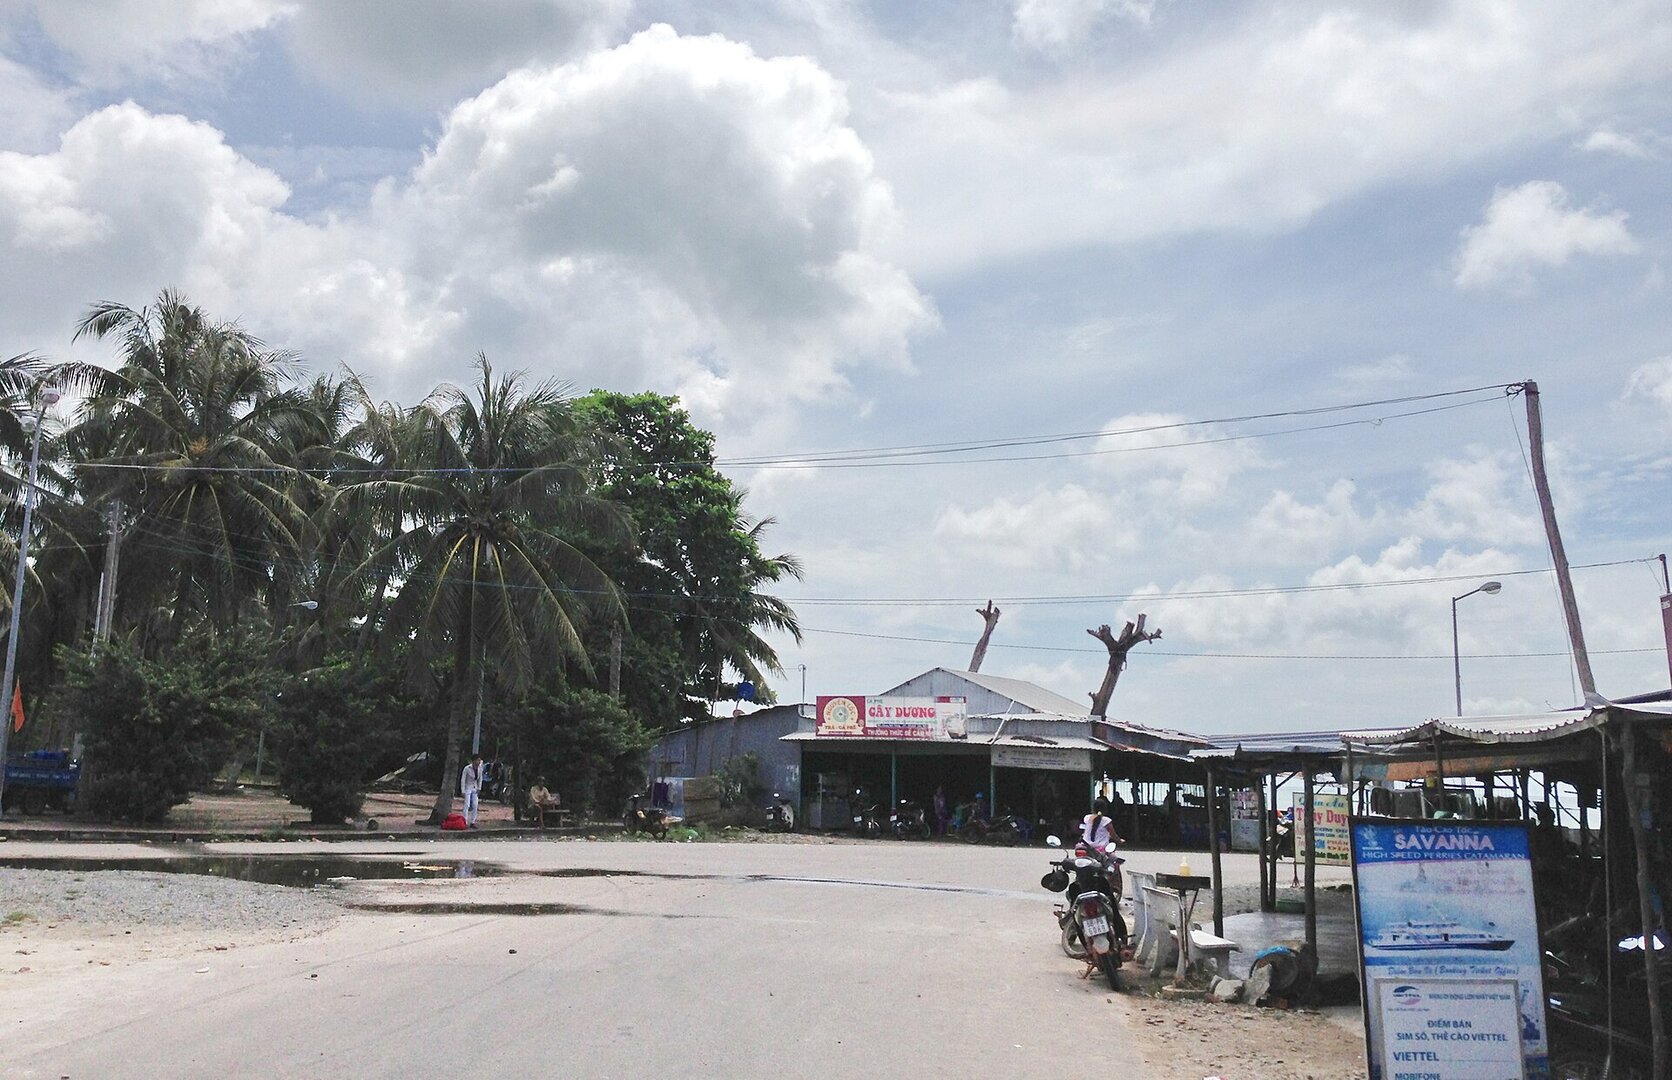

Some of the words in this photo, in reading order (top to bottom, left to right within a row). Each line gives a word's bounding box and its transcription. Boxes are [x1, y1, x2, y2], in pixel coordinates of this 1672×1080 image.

[868, 704, 892, 718] CÂY
[895, 706, 936, 718] DƯƠNG
[1395, 833, 1495, 851] SAVANNA
[1362, 851, 1388, 859] HIGH
[1391, 851, 1421, 859] SPEED
[1464, 852, 1526, 860] CATAMARAN
[1452, 1019, 1472, 1029] BÁN
[1396, 1032, 1413, 1041] SIM
[1450, 1032, 1470, 1041] CÀO
[1471, 1033, 1508, 1042] VIETTEL
[1393, 1051, 1440, 1062] VIETTEL
